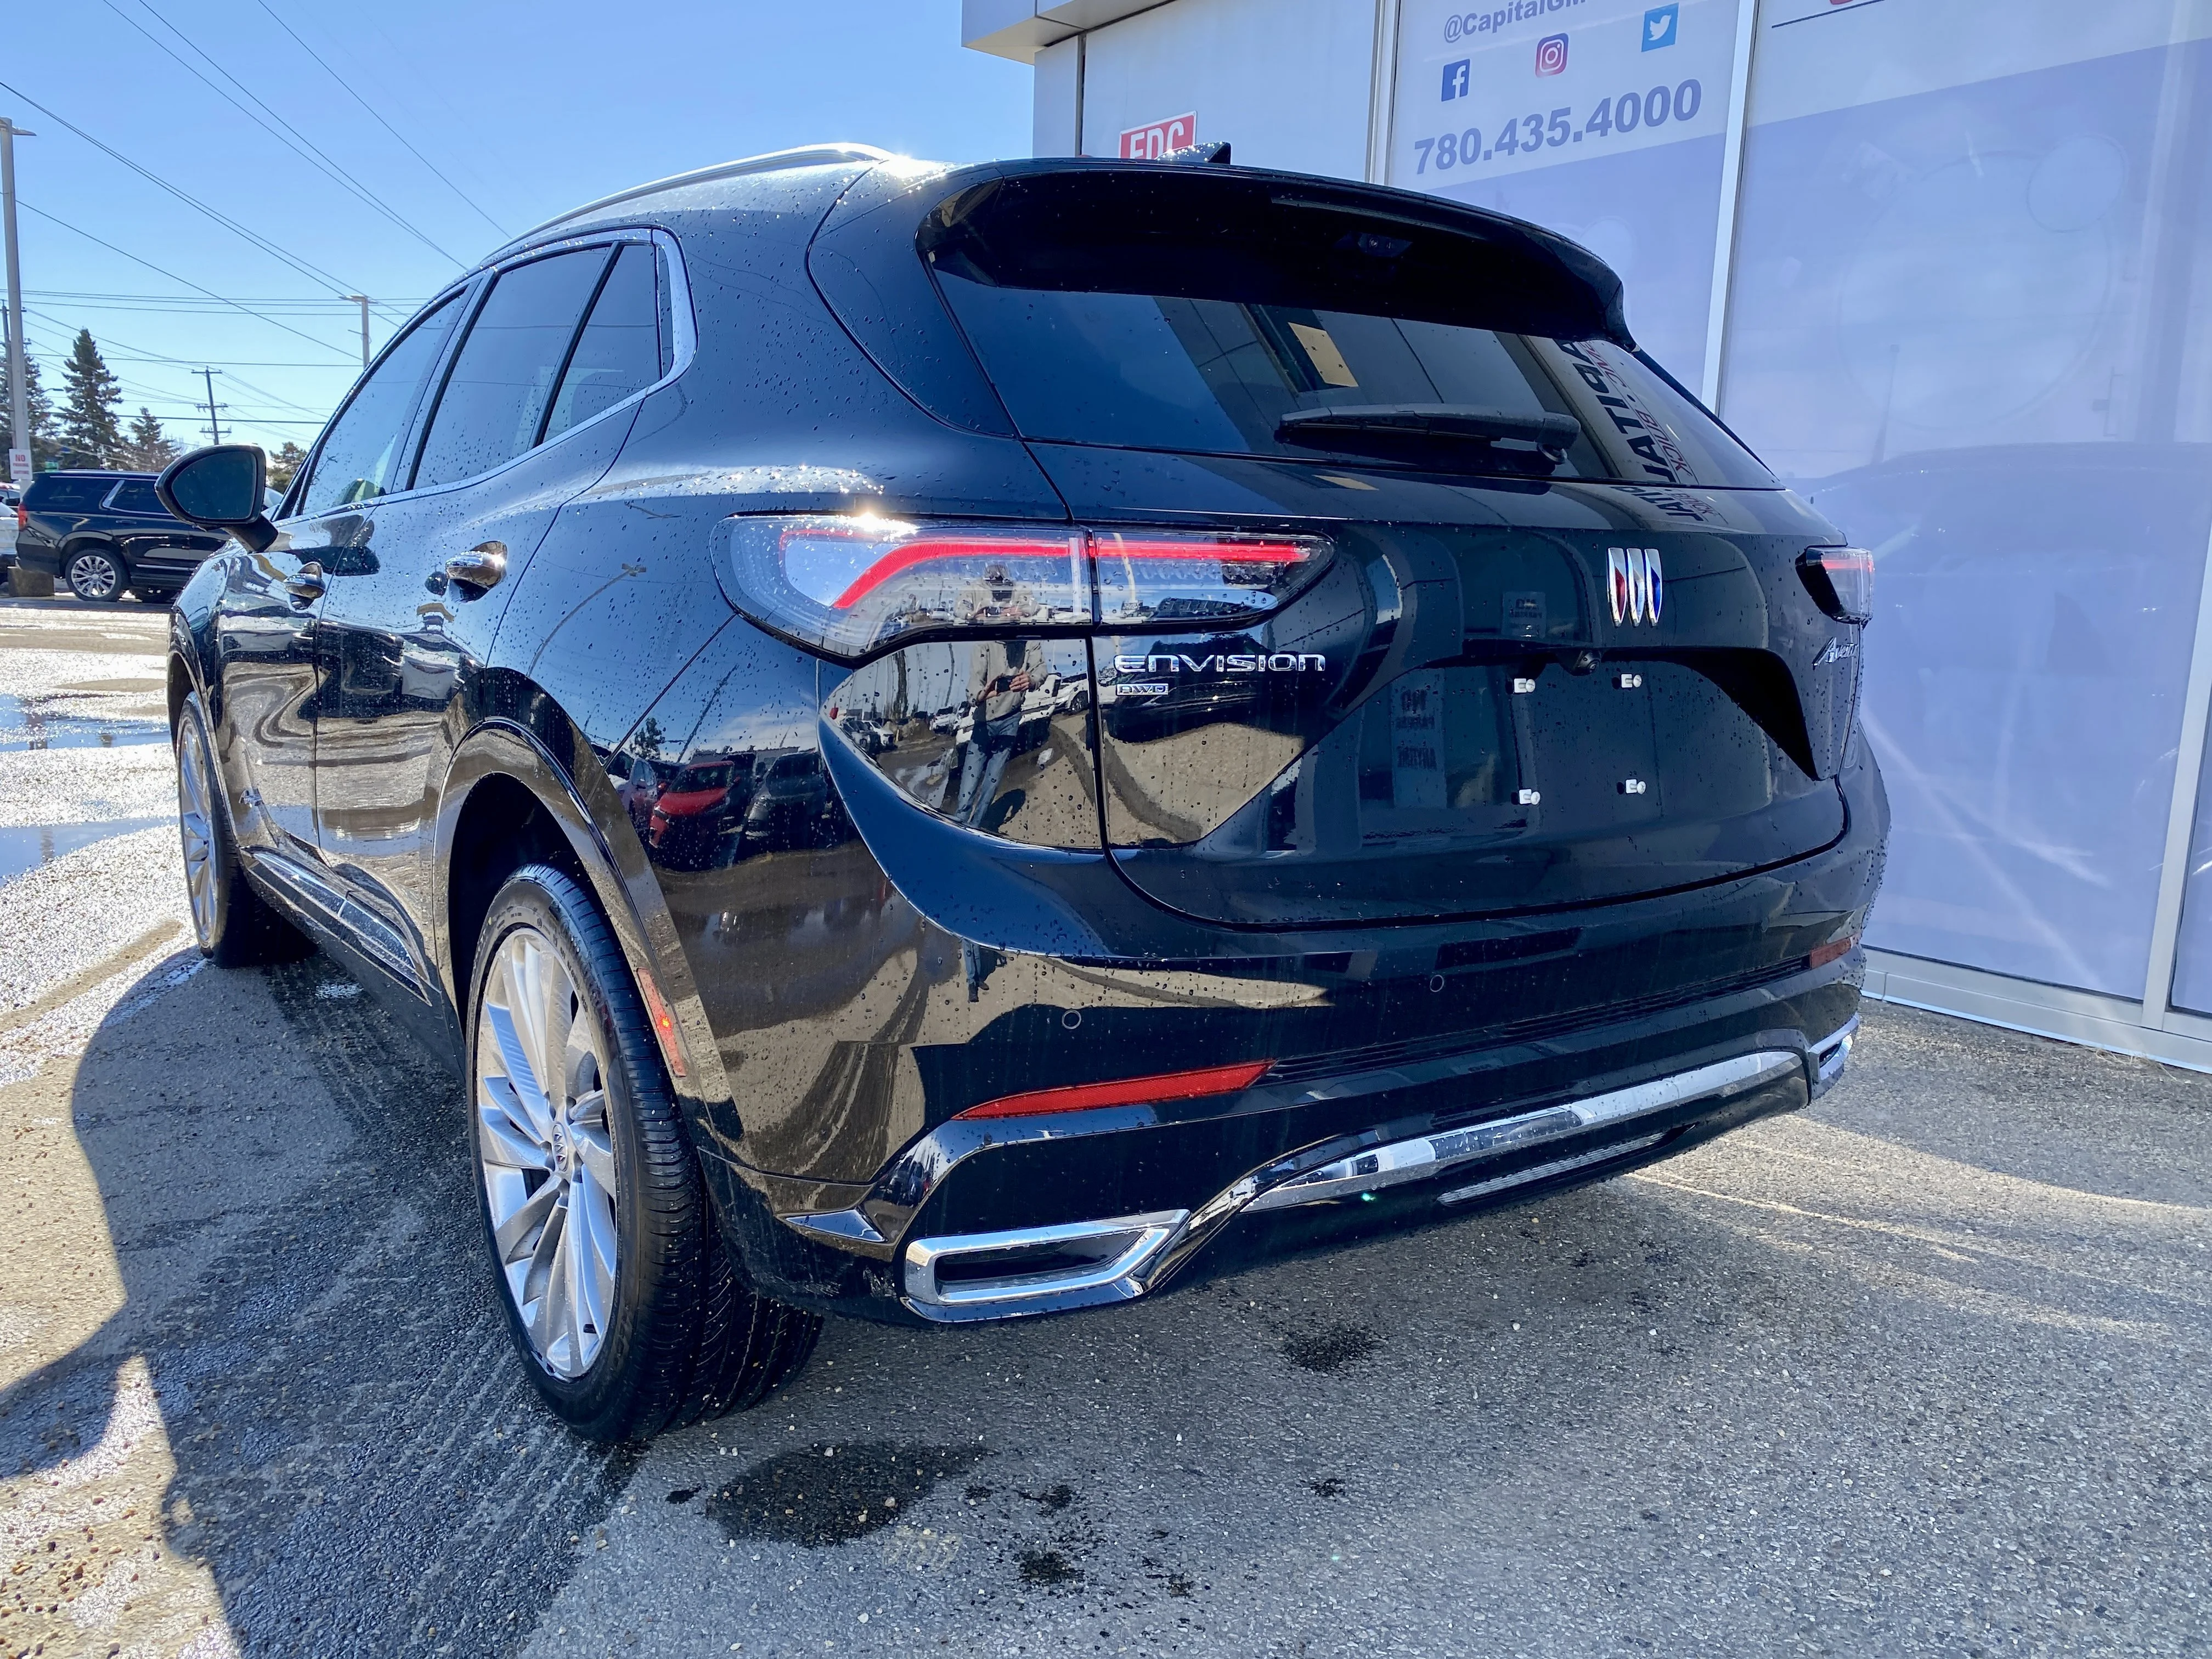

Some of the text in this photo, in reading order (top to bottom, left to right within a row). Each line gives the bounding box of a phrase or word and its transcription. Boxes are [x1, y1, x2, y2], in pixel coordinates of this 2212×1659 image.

[1444, 0, 1585, 43] @CapitalG
[1414, 79, 1701, 174] 780.435.4000
[1114, 654, 1325, 673] ENVISION
[1118, 684, 1167, 694] AWD
